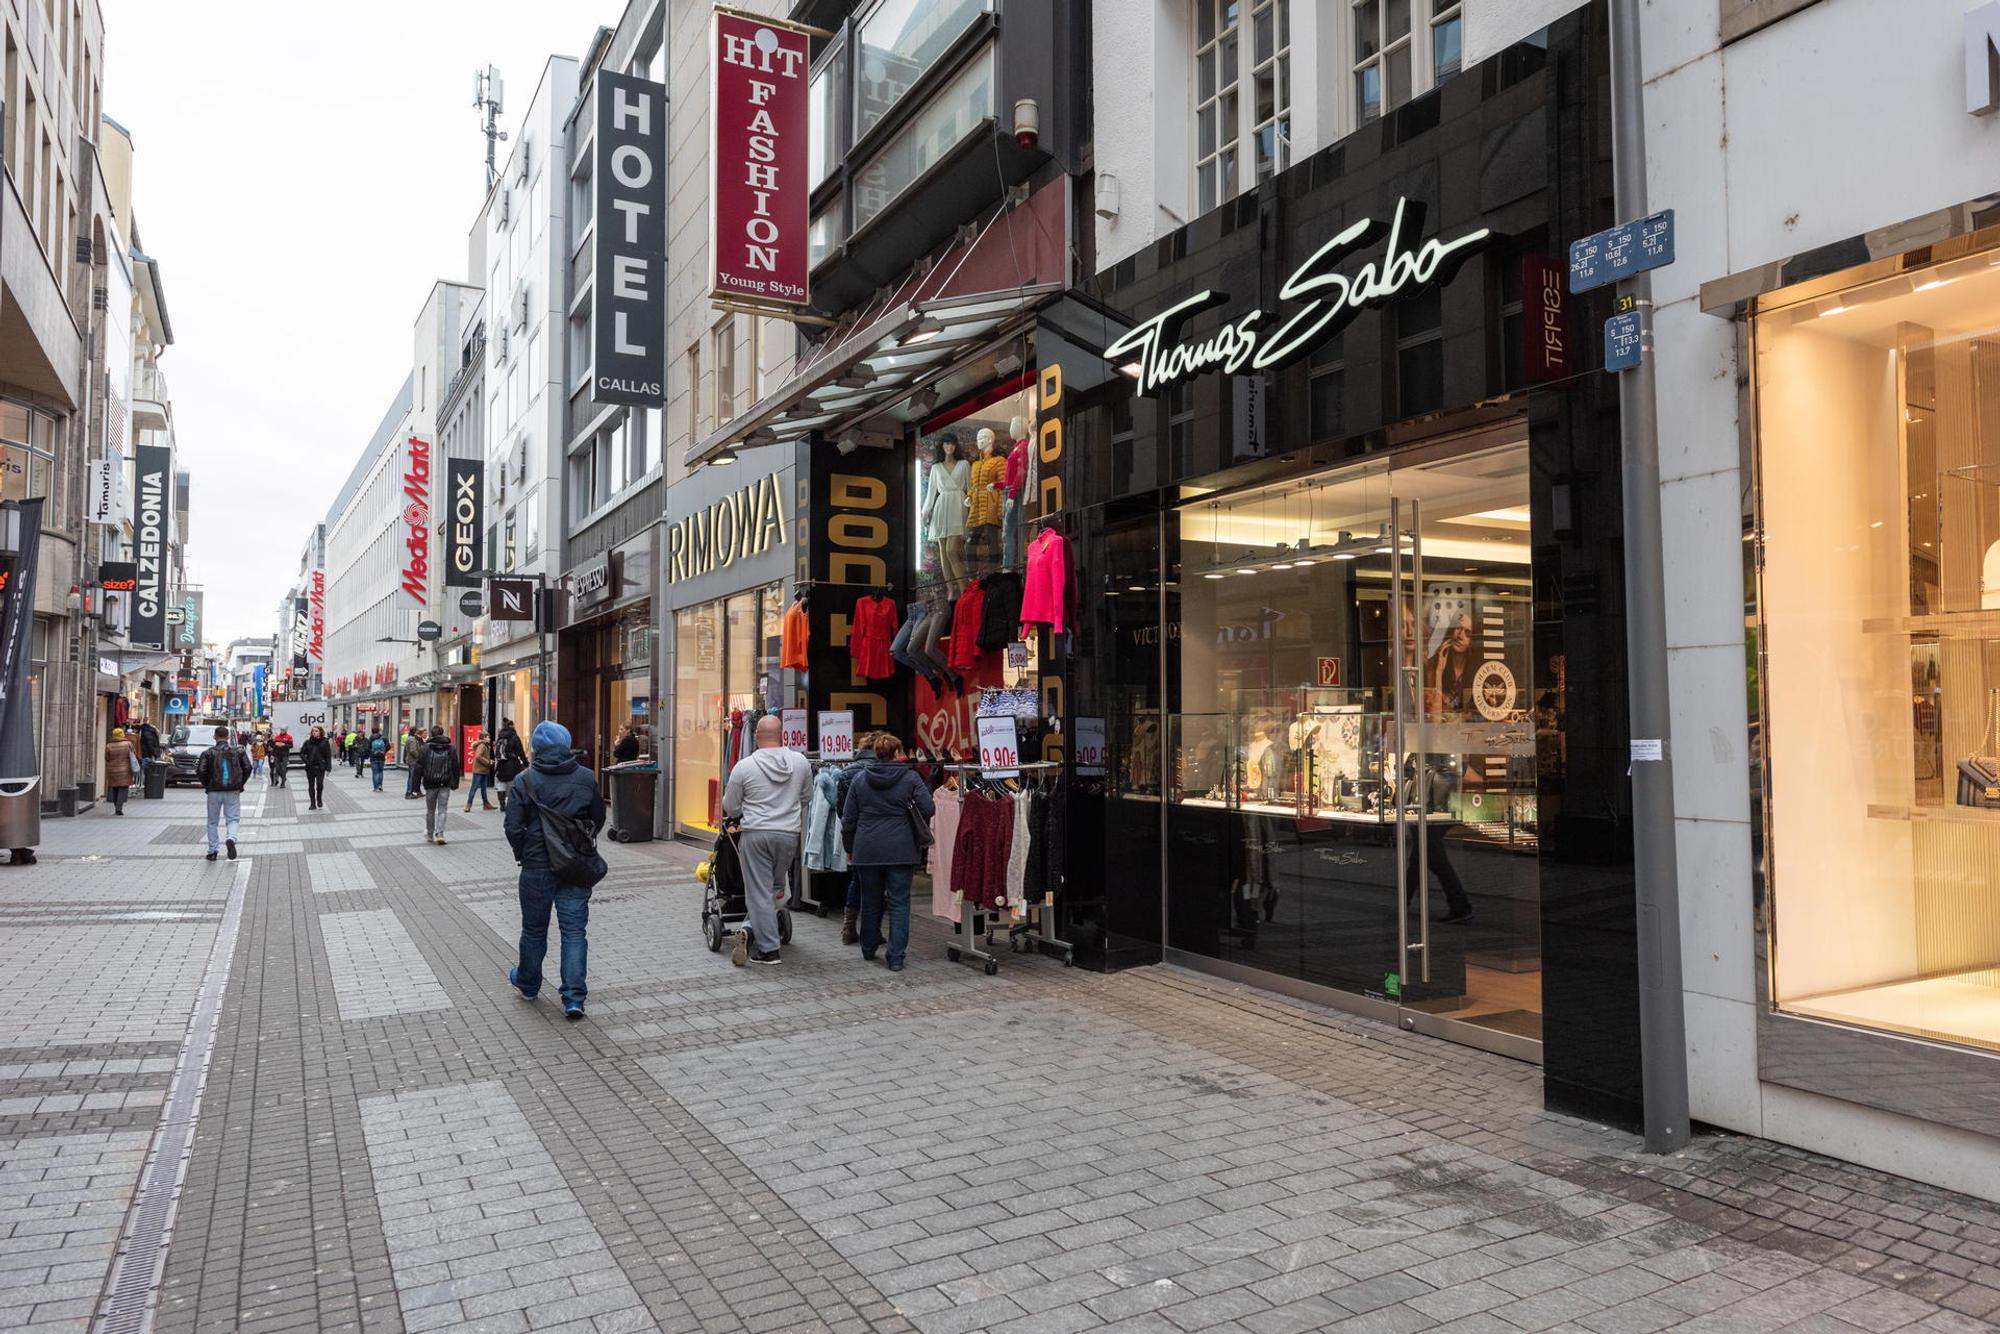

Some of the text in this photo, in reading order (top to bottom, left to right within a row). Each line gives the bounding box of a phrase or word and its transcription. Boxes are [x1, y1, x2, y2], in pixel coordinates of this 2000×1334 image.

[723, 33, 803, 78] HIT
[745, 79, 779, 272] FASHION
[610, 88, 653, 357] HOTEL
[1654, 221, 1668, 232] 150
[1618, 233, 1631, 244] 150
[1585, 245, 1598, 257] 150
[1647, 245, 1663, 256] 11.8
[720, 272, 805, 297] Young Style
[1104, 195, 1490, 397] Thomas Sabo
[1620, 296, 1633, 311] 31
[1621, 325, 1635, 335] 150
[598, 376, 661, 396] CALLAS
[455, 472, 476, 572] GEOX
[669, 472, 788, 585] RIMOWA
[138, 471, 163, 618] CALZEDONIA
[103, 579, 136, 590] size?
[300, 713, 325, 726] dpd
[821, 735, 852, 755] 19,90€
